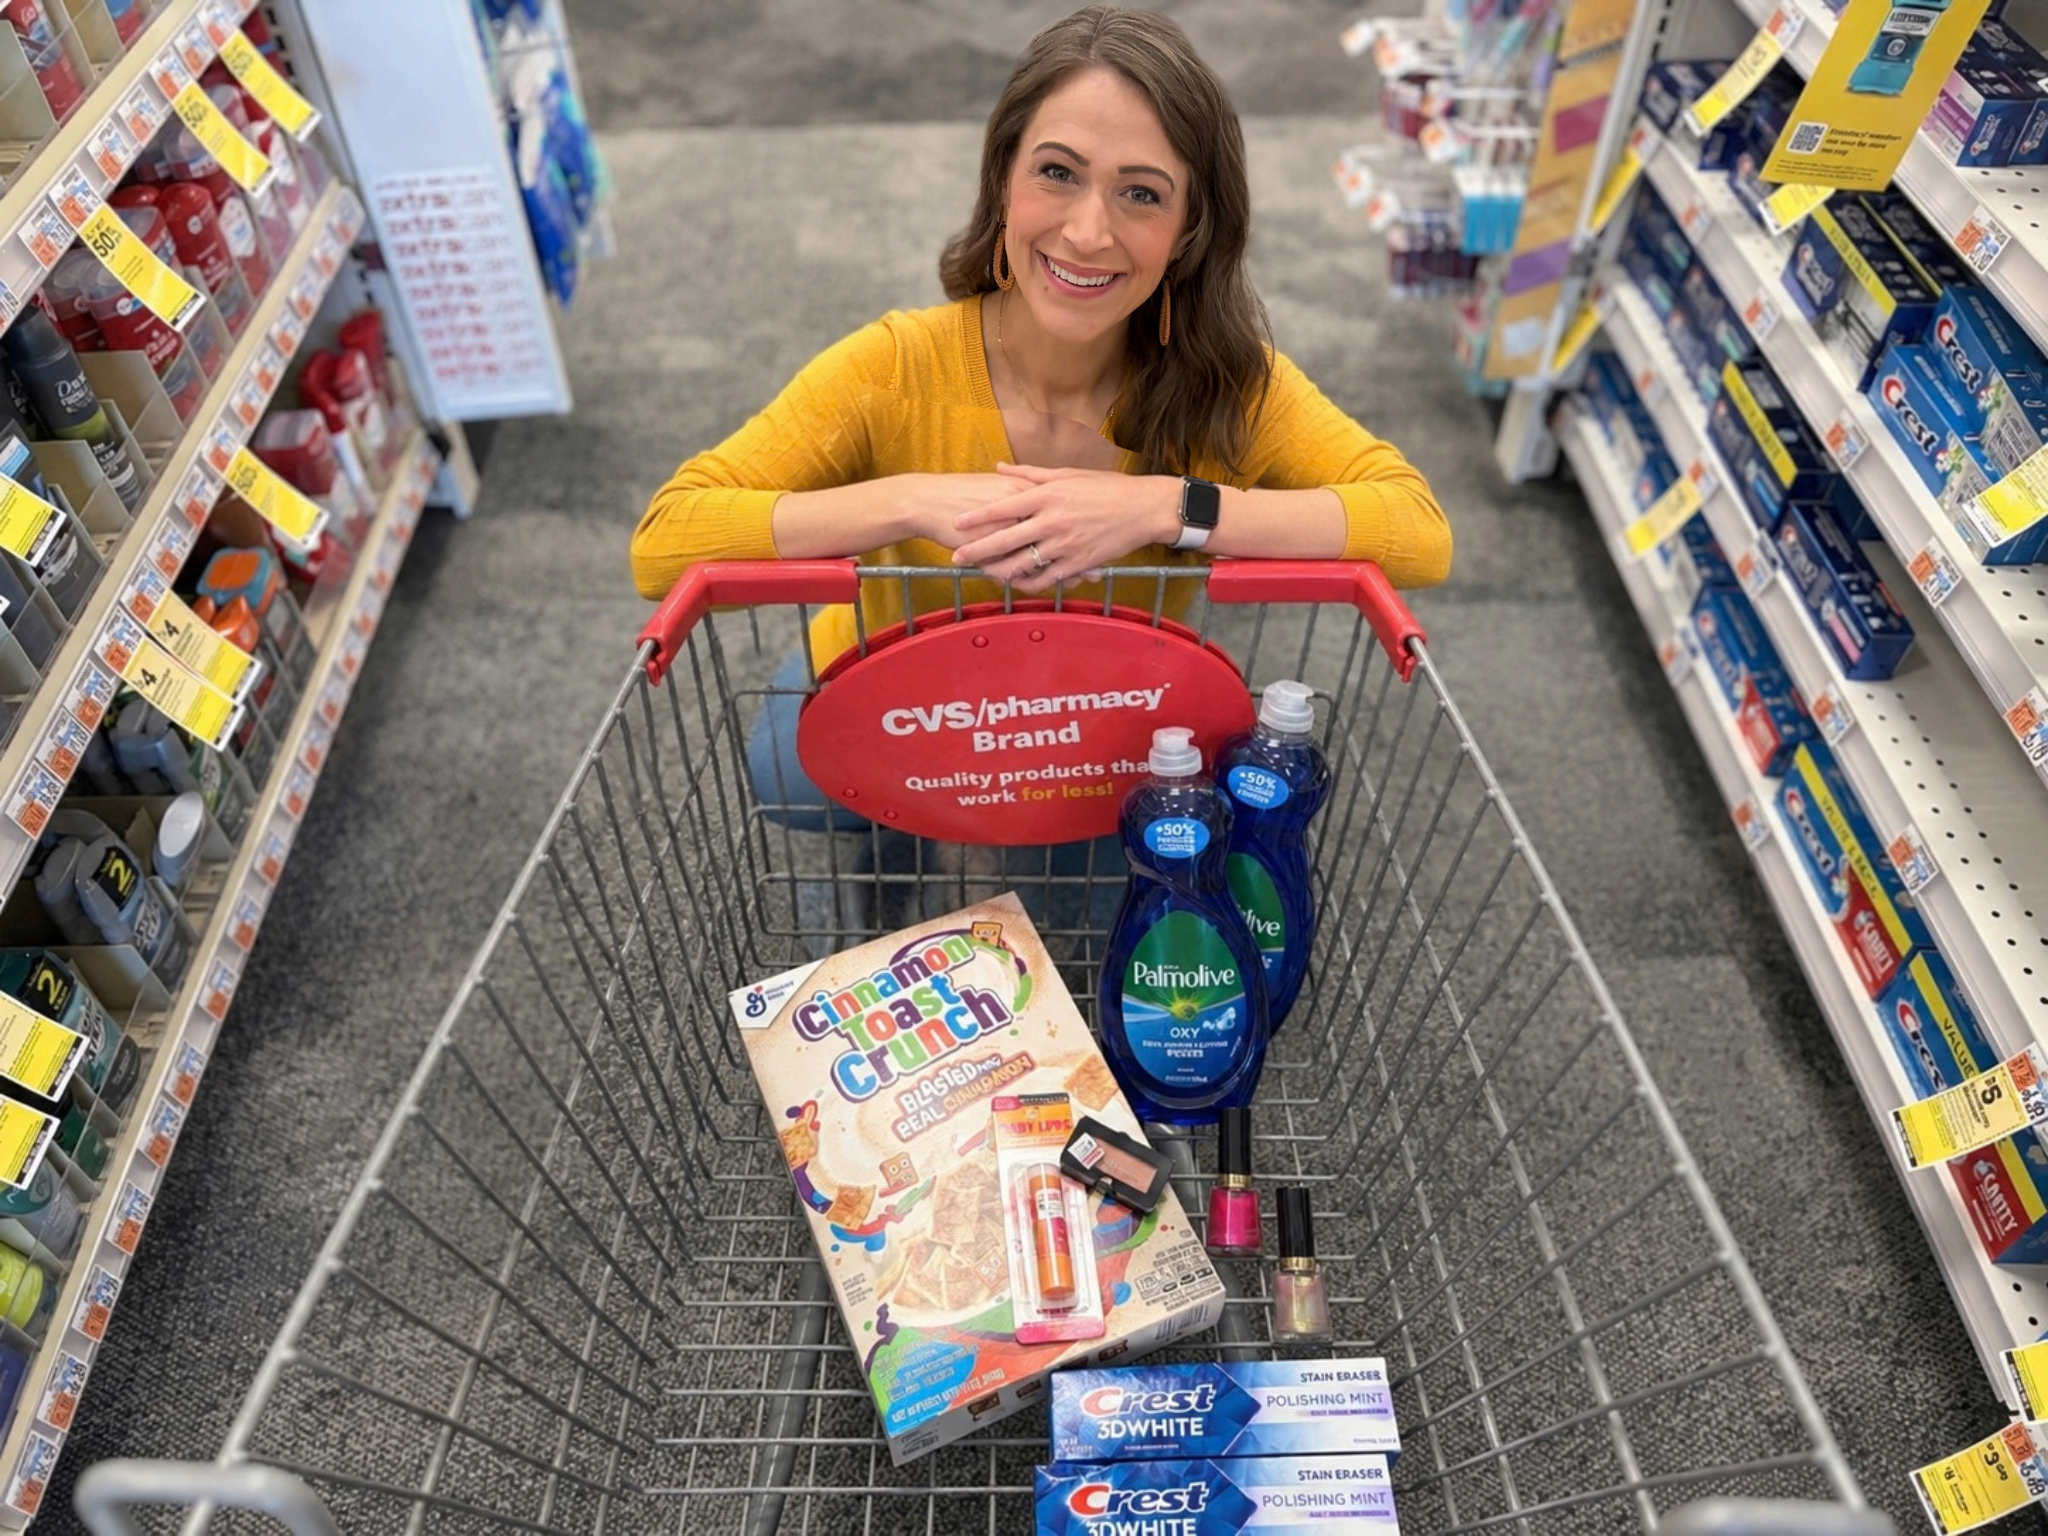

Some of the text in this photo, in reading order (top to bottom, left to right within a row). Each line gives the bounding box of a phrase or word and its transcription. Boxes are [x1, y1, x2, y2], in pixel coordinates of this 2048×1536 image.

[881, 686, 1166, 737] CVS/pharmacy
[972, 721, 1081, 753] Brand
[904, 758, 1150, 791] Quality products tha
[958, 781, 1114, 806] work for less!
[109, 858, 132, 893] 2
[37, 969, 63, 1006] 2
[1133, 961, 1235, 988] Palmolive
[1170, 1026, 1200, 1039] OXY
[1300, 1369, 1381, 1383] STAIN ERASER
[1082, 1384, 1216, 1418] Crest
[1266, 1392, 1384, 1408] POLISHING MINT
[1097, 1416, 1204, 1440] 3DWHITE
[1297, 1467, 1383, 1481] STAIN ERASER
[1069, 1482, 1210, 1517] Crest
[1262, 1491, 1386, 1508] POLISHING MINT
